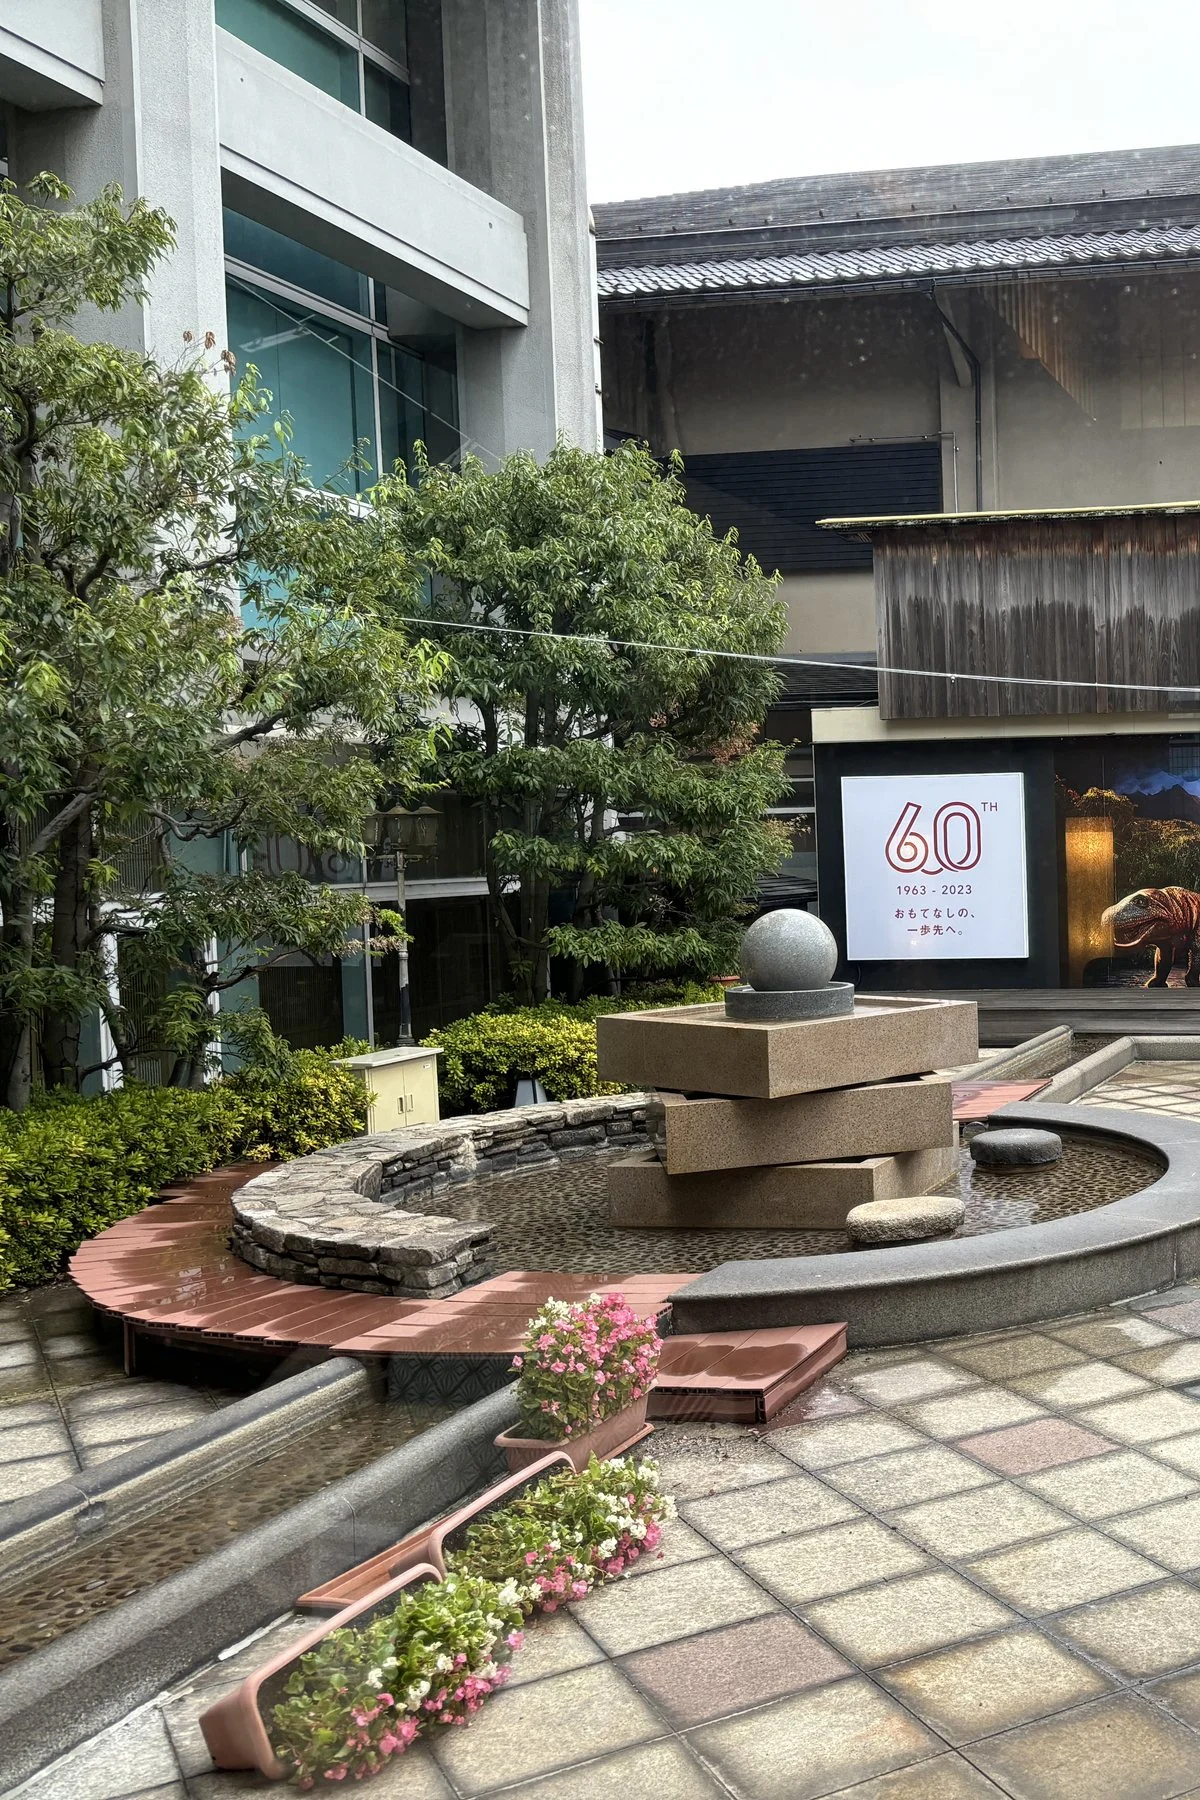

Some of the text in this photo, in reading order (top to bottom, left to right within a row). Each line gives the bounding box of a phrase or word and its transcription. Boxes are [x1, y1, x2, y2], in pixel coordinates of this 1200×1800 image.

[897, 885, 926, 896] 1963
[941, 885, 972, 895] 2023
[894, 908, 975, 919] おもてなしの、
[907, 925, 963, 936] 一歩先へ。
